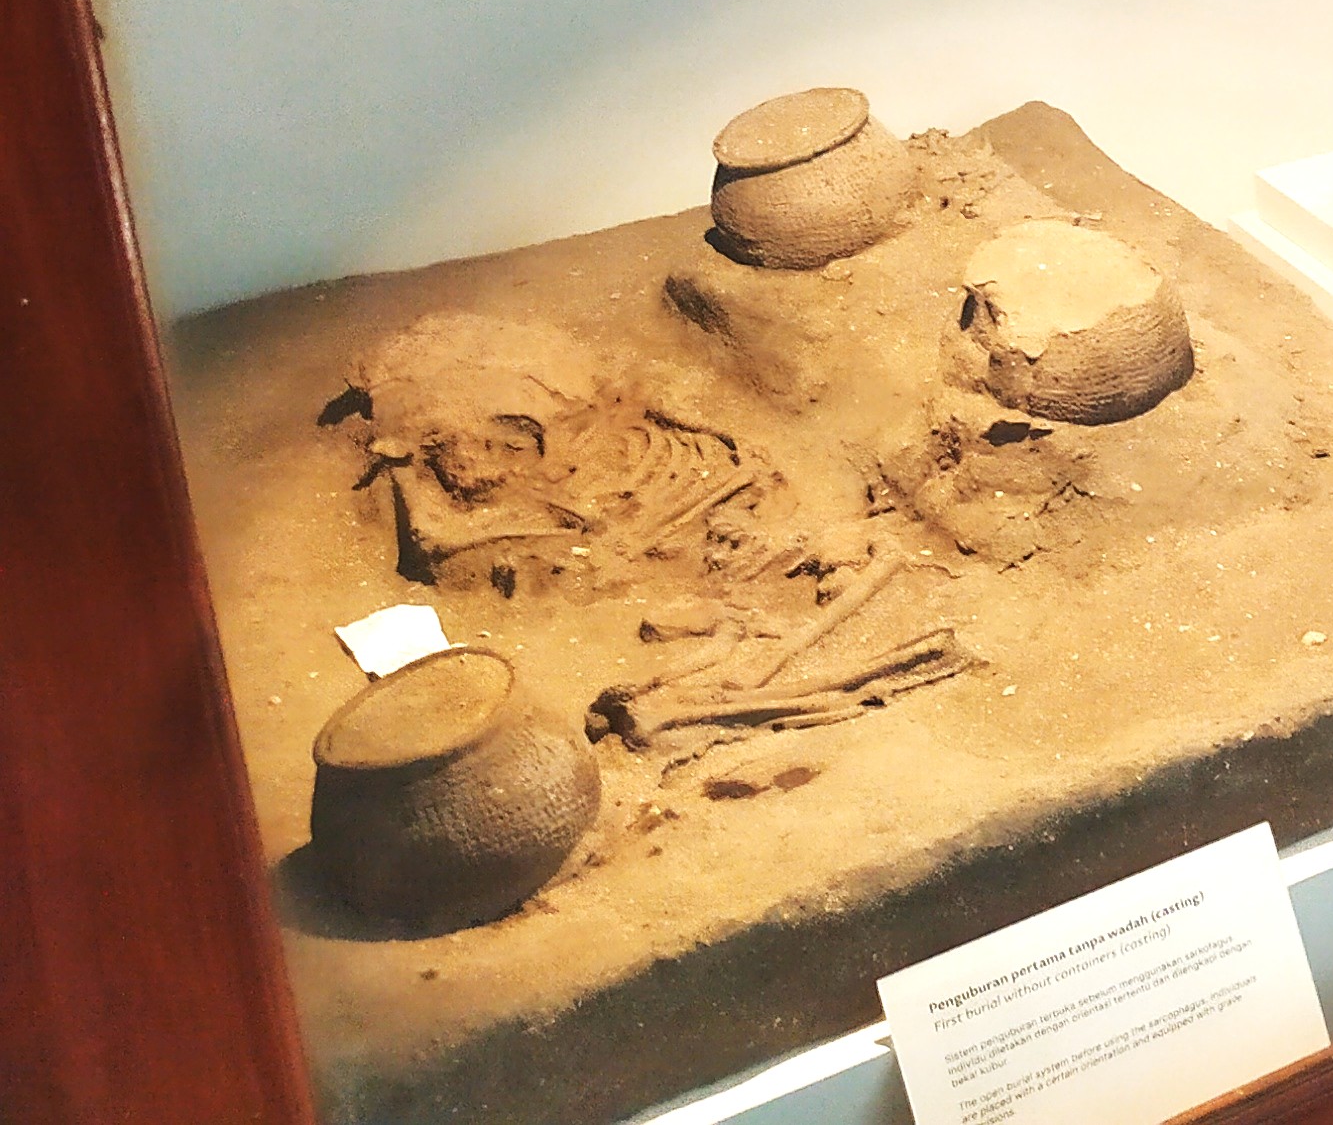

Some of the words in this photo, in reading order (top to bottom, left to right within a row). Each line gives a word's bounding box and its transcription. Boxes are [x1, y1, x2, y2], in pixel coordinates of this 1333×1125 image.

[928, 975, 1009, 1013] Penguburan
[1011, 951, 1066, 982] pertama
[1068, 935, 1106, 955] tanpa
[1107, 915, 1149, 938] wadah
[1150, 891, 1205, 922] (casting)
[933, 1013, 963, 1032] First
[965, 995, 1001, 1019] burial
[1003, 976, 1052, 1002] without
[1054, 950, 1117, 982] containers
[1119, 924, 1171, 954] (casting)
[944, 1044, 978, 1063] Sistem
